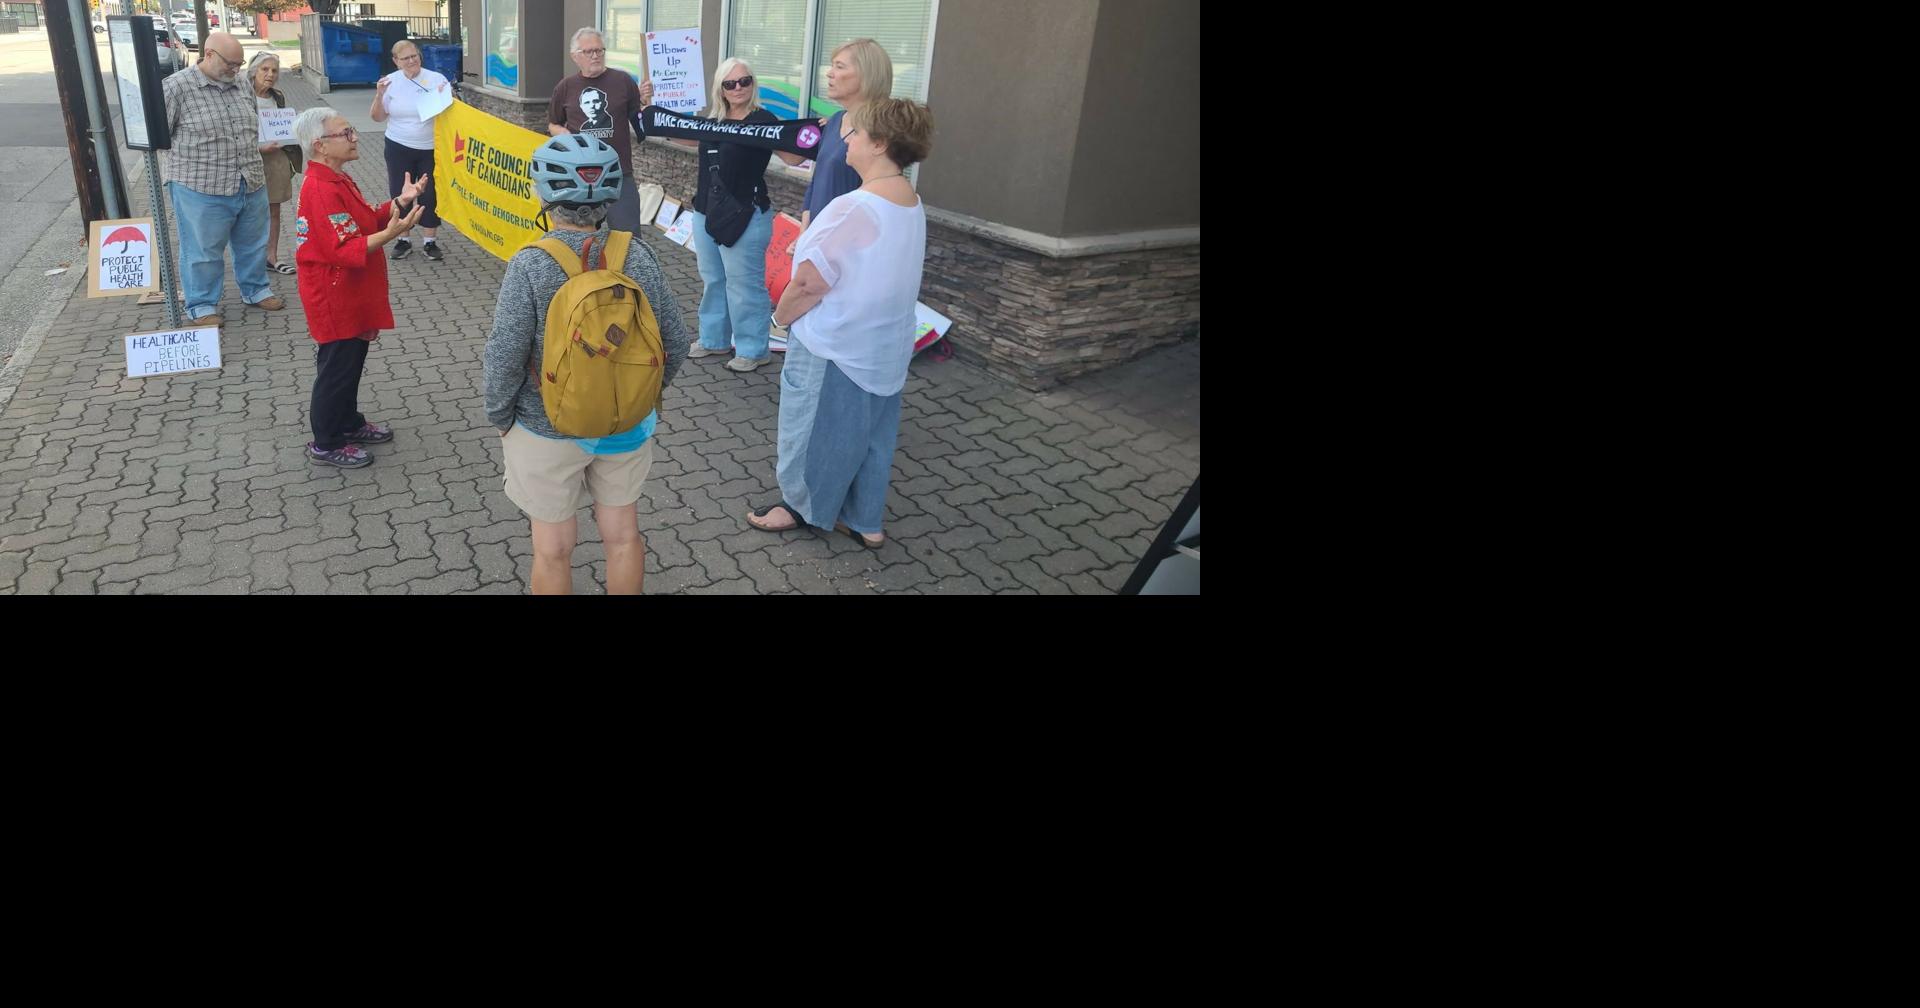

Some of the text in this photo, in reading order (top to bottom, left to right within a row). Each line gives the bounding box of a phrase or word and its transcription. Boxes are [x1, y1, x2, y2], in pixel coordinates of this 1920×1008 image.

[653, 43, 687, 55] Elbows
[667, 56, 681, 69] Up
[653, 82, 684, 91] PROTECT
[655, 99, 697, 109] HEALTH CARE
[653, 112, 677, 128] MAKE
[739, 124, 785, 140] BETTER
[274, 129, 289, 137] CARE
[467, 136, 534, 180] THE COUNCIL
[466, 155, 531, 200] OF CANADIANS
[492, 205, 535, 230] DEMOCRACY
[102, 255, 144, 267] PROTECT
[110, 264, 143, 275] PUBLIC
[110, 272, 144, 283] HEALTH
[118, 280, 144, 289] CARE
[132, 331, 199, 349] HEALTHCARE
[159, 344, 201, 359] BEFORE
[144, 355, 211, 374] PIPELINES
